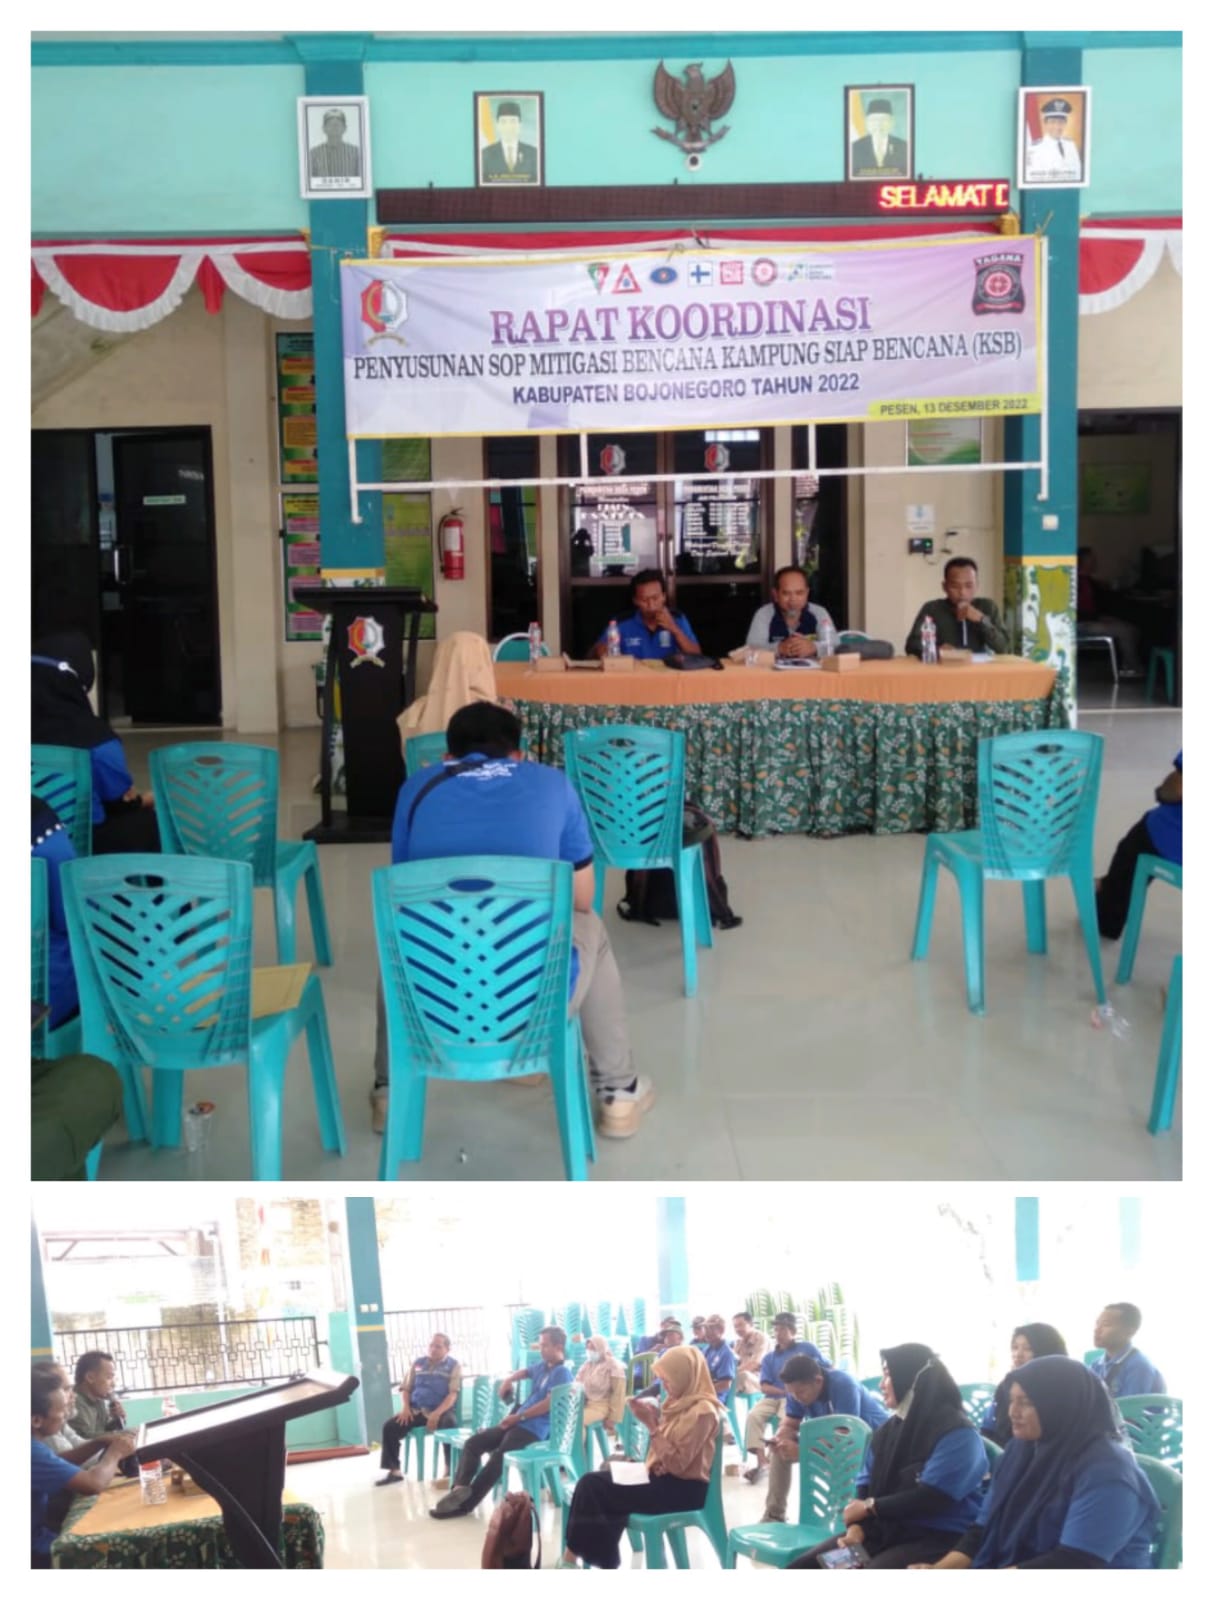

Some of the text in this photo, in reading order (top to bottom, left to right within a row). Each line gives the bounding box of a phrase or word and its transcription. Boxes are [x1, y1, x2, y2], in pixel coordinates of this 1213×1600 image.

[880, 184, 993, 208] SELAMAT
[490, 297, 872, 346] RAPAT KOORDINASI
[354, 331, 1022, 379] PENYUSUNAN SOP MITIGASI BENCANA KAMPUNG SIAP BENCANA (KSB)
[513, 373, 860, 403] KABUPATEN BOJONEGORO TAHUN 2022
[880, 399, 1028, 416] PESEN, 13 DESEMBER 2022
